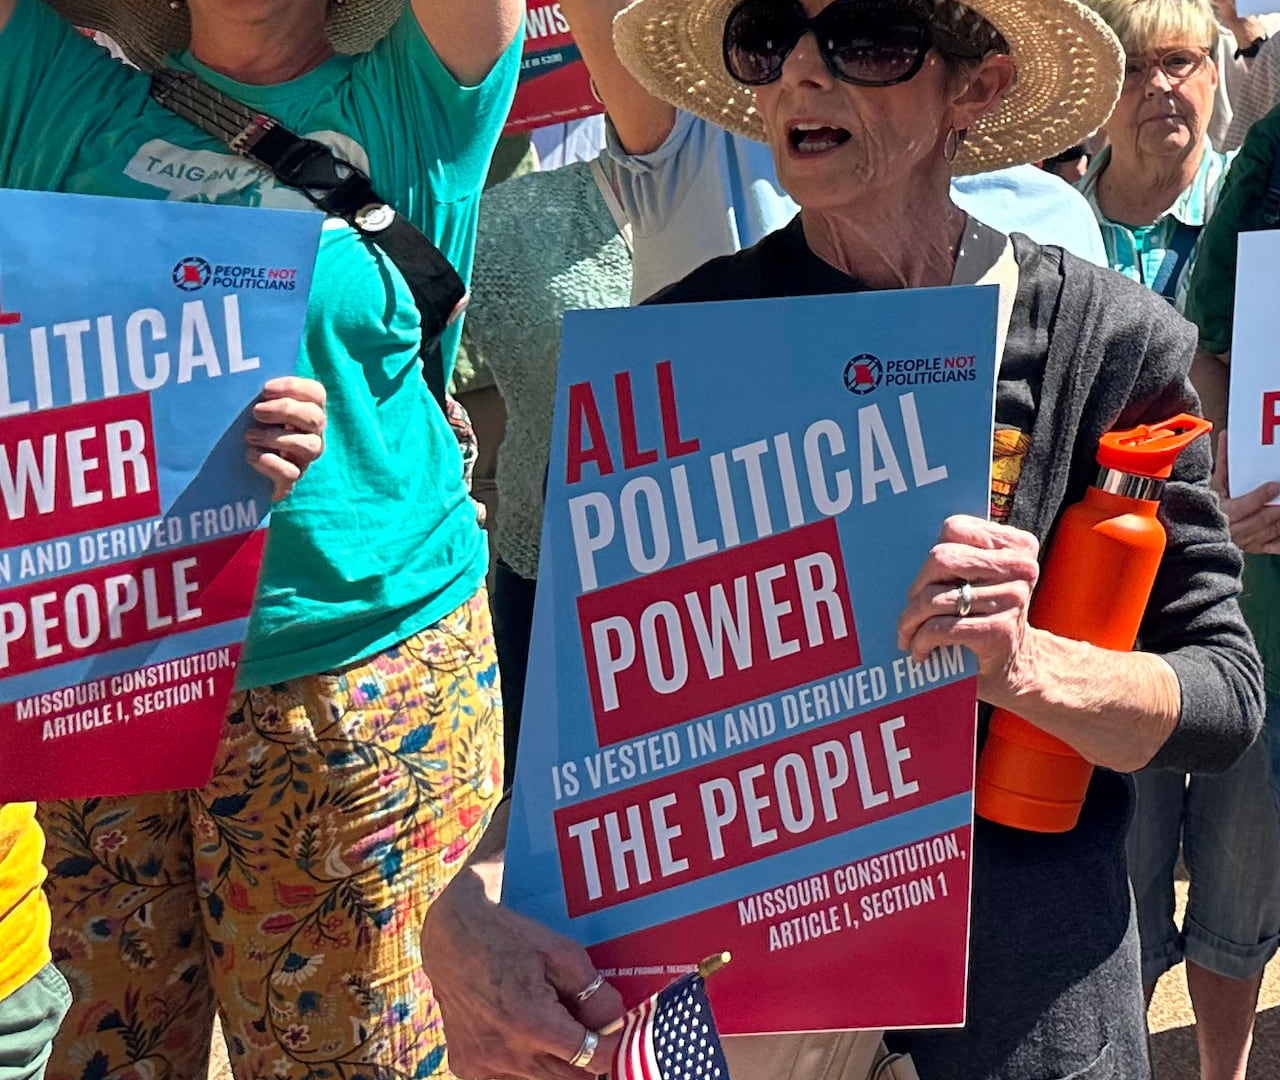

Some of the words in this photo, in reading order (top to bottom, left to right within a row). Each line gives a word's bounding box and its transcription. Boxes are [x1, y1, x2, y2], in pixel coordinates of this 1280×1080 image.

[213, 277, 295, 291] POLITICIANS
[214, 265, 265, 278] PEOPLE
[268, 269, 296, 279] NOT
[884, 367, 977, 386] POLITICIANS
[885, 357, 943, 373] PEOPLE
[945, 354, 976, 369] NOT
[565, 360, 700, 486] ALL
[568, 392, 949, 592] POLITICAL
[591, 551, 849, 712] POWER
[16, 679, 107, 721] MISSOURI
[110, 650, 237, 699] CONSTITUTION,
[41, 708, 113, 741] ARTICLE
[134, 683, 205, 721] SECTION
[208, 678, 216, 700] 1
[551, 765, 579, 800] IS
[585, 731, 682, 792] VESTED
[686, 720, 717, 760] IN
[725, 706, 776, 749] AND
[783, 674, 888, 735] DERIVED
[567, 793, 689, 902] THE
[701, 716, 919, 861] PEOPLE
[738, 872, 830, 926] MISSOURI
[834, 832, 967, 899] CONSTITUTION,
[767, 911, 840, 953] ARTICLE
[859, 881, 932, 924] SECTION
[936, 873, 948, 899] 1
